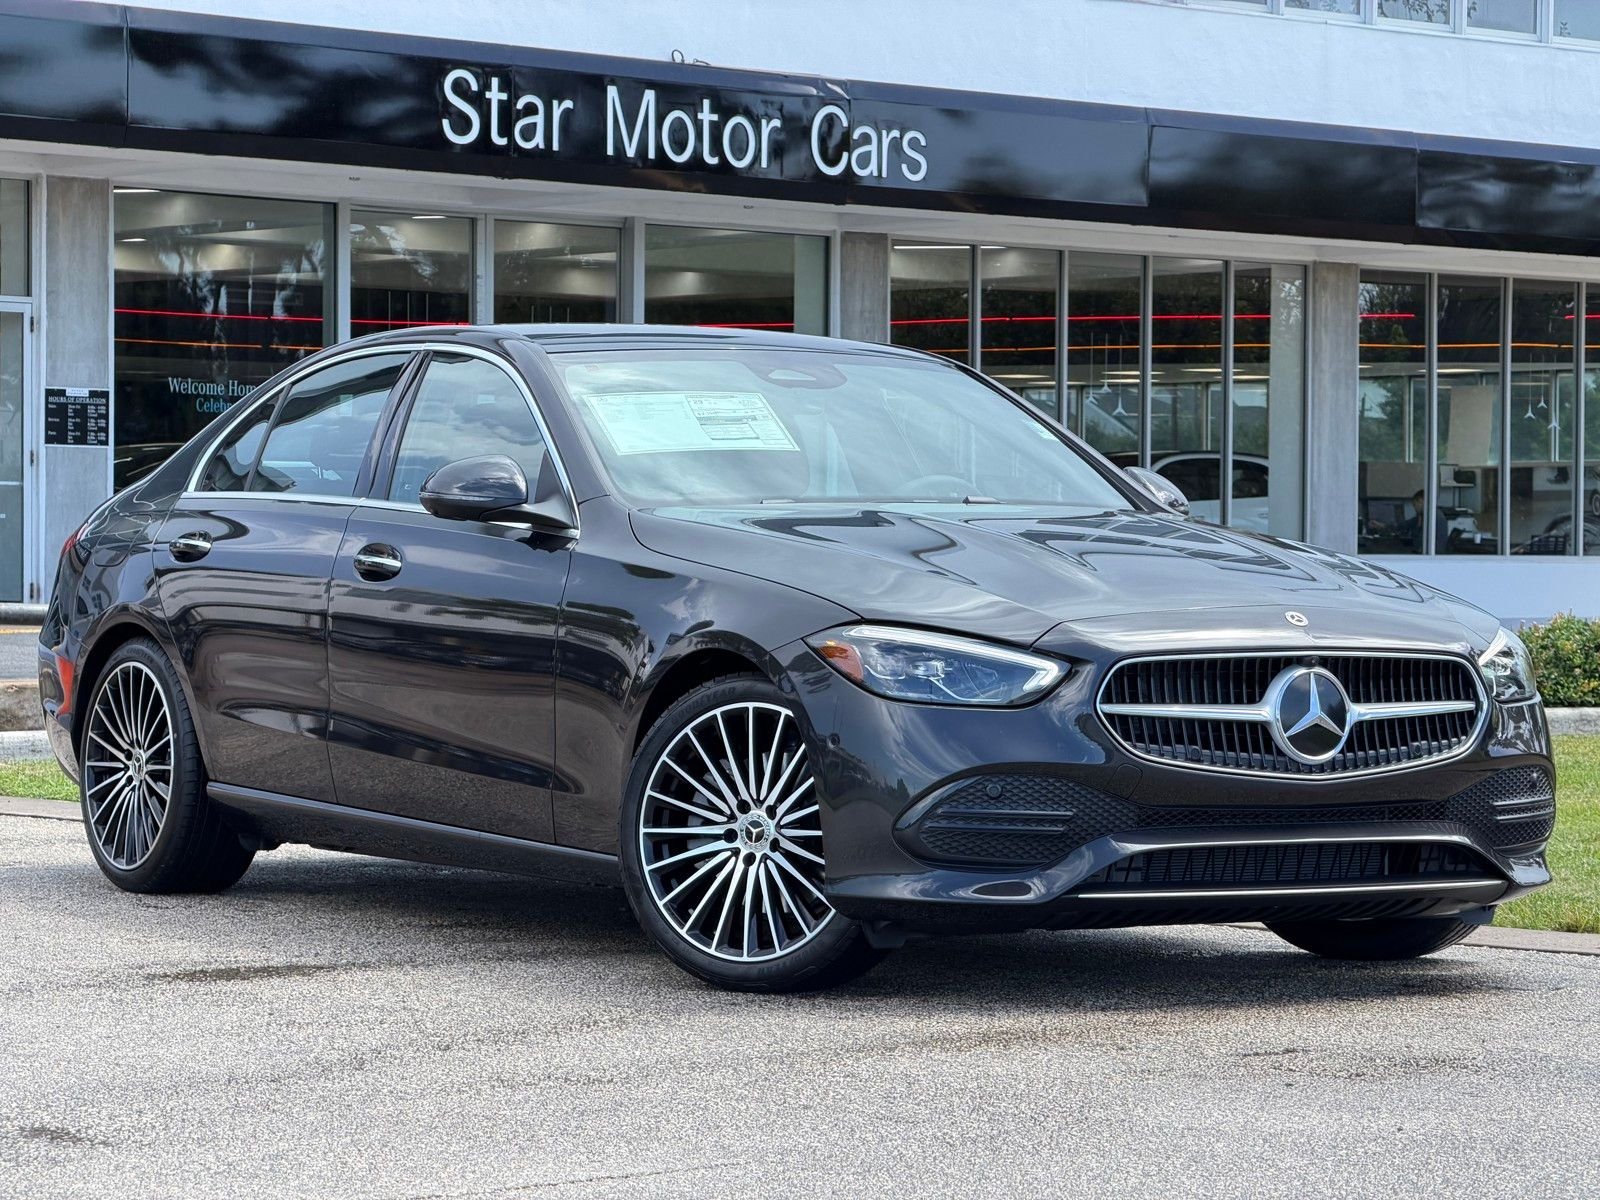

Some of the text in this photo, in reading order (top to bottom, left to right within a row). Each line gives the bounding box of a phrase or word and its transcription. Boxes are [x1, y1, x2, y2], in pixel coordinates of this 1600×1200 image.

[441, 68, 928, 182] Star Motor Cars
[168, 377, 225, 396] Welcome
